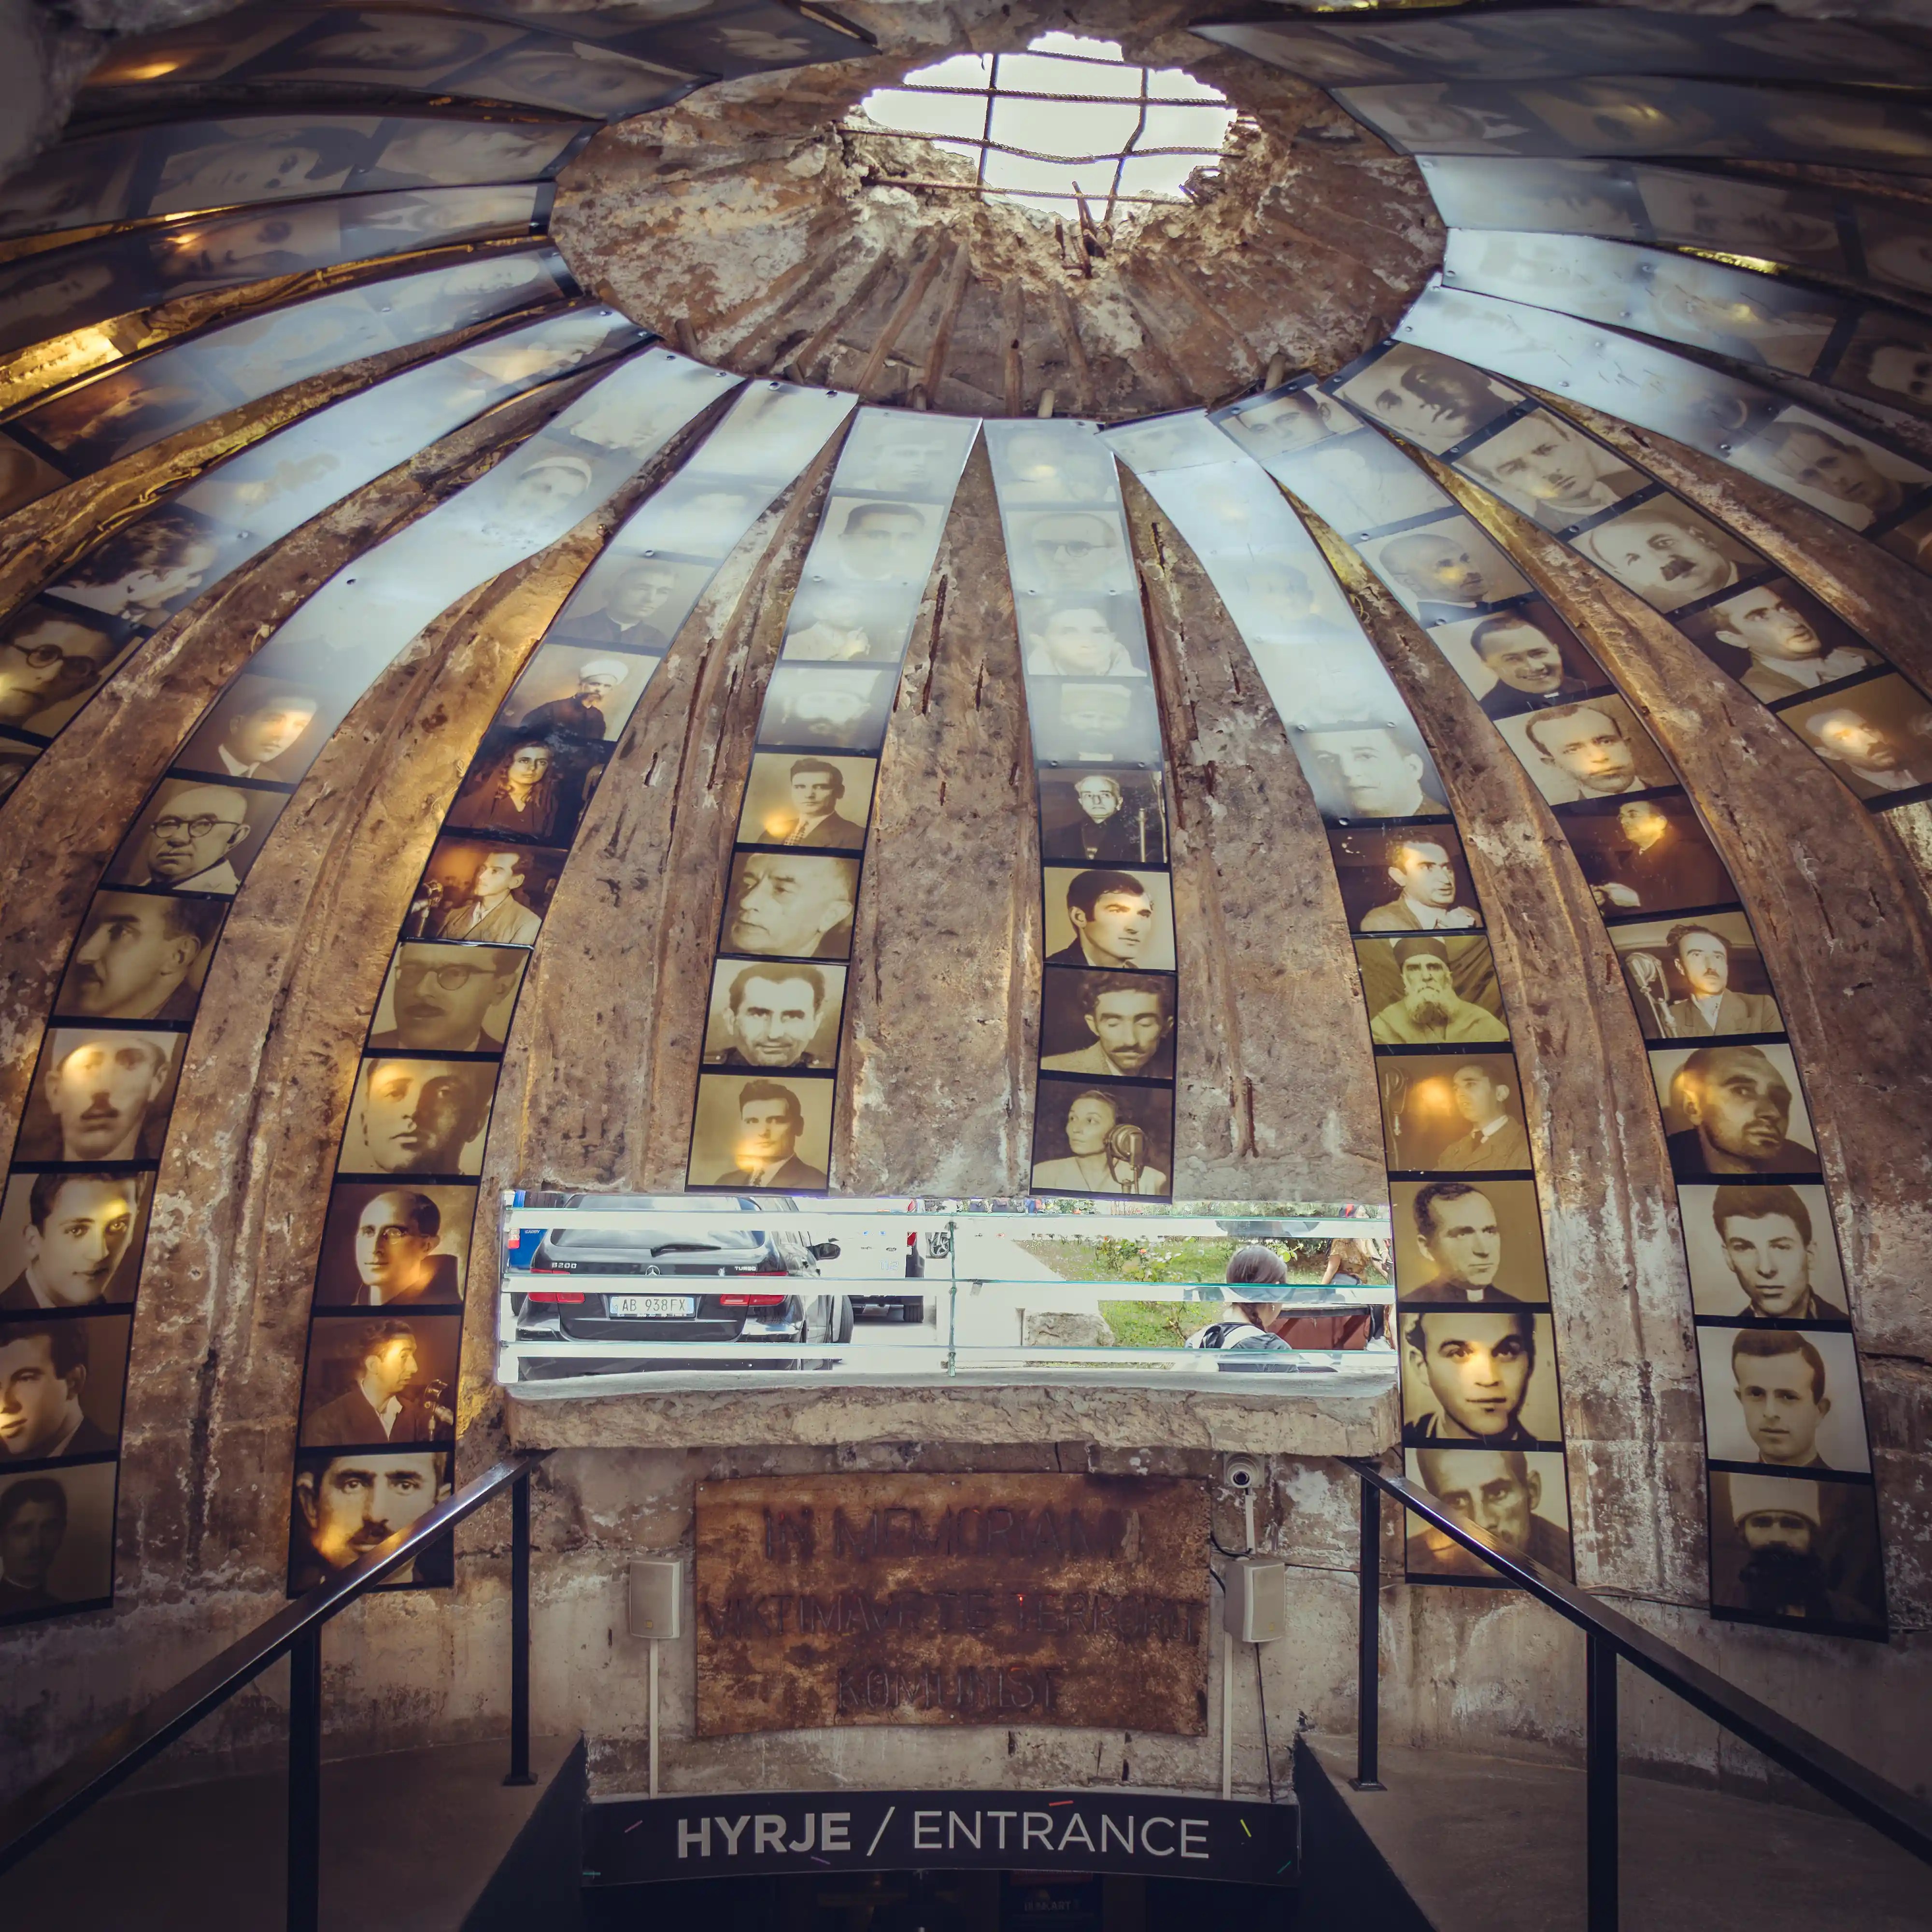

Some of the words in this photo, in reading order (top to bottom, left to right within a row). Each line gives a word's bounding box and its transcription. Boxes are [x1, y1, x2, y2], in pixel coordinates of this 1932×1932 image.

[622, 1299, 637, 1311] AB
[678, 1812, 851, 1858] HYRJE
[914, 1811, 1209, 1858] ENTRANCE
